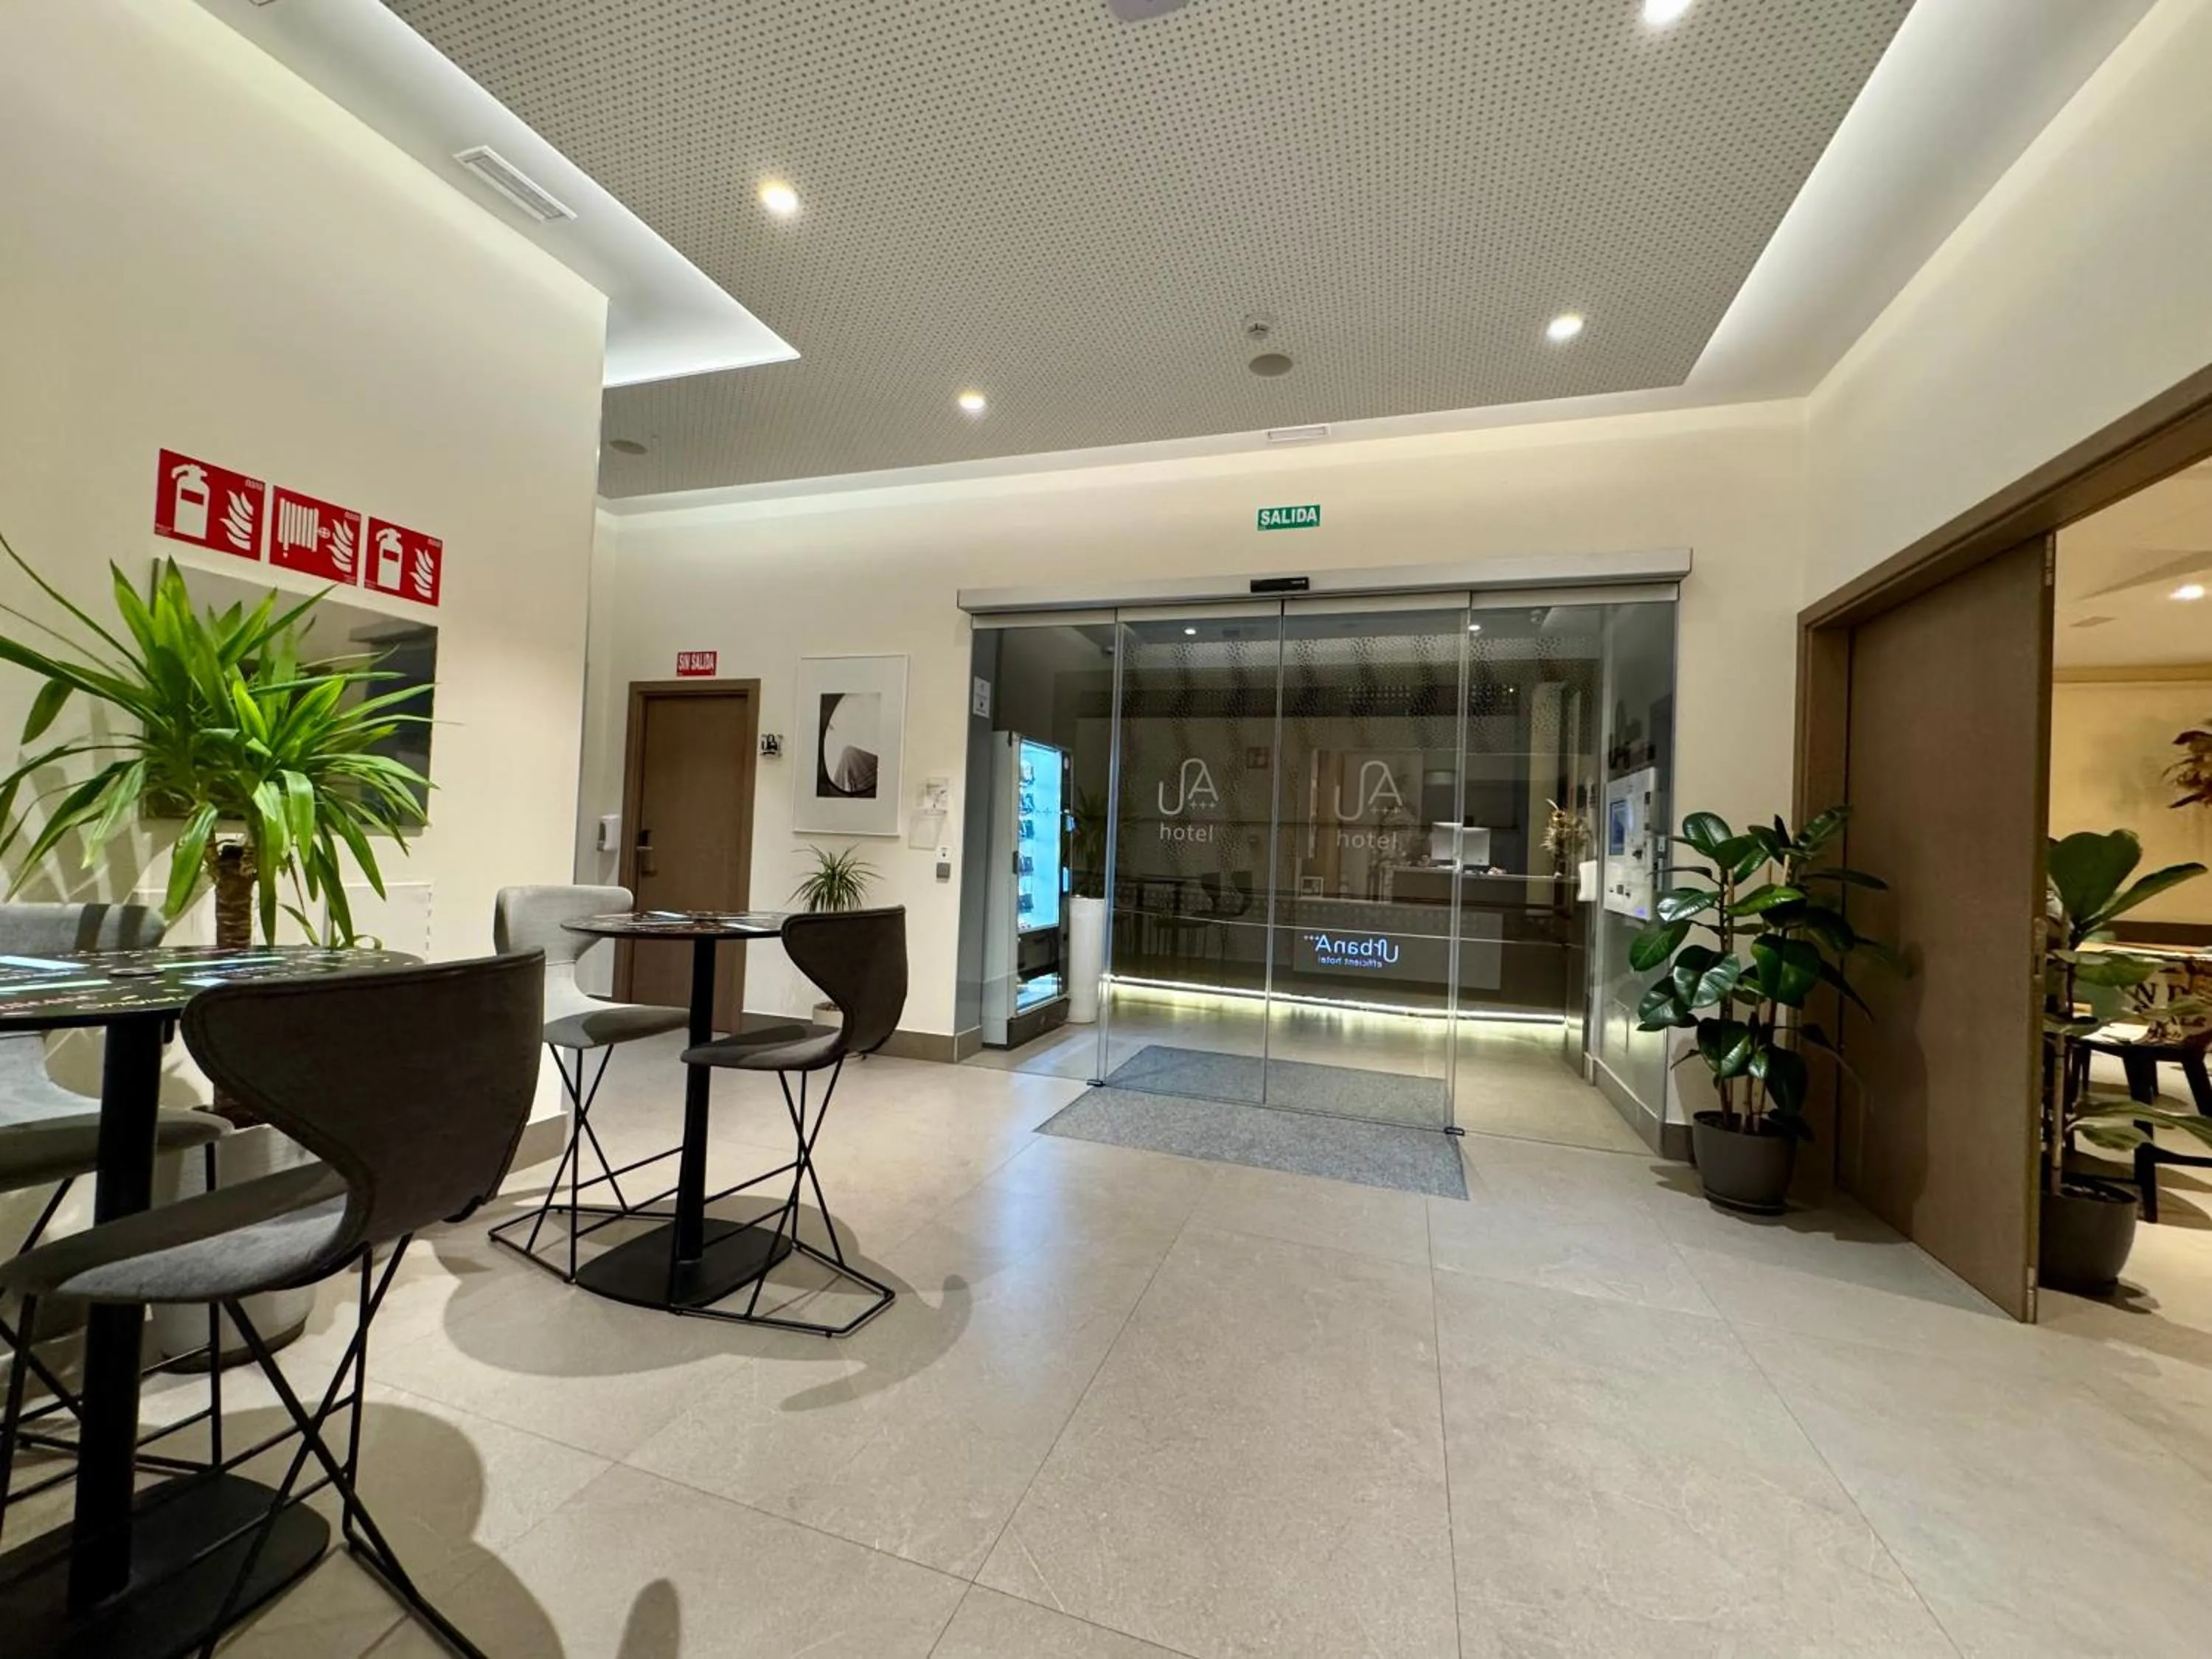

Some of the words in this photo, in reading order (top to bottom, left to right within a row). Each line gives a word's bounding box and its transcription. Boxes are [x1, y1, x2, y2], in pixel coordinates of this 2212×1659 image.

[1260, 507, 1318, 525] SALIDA
[679, 653, 690, 671] SIN
[691, 653, 714, 670] SALIDA
[1160, 822, 1214, 843] hotel
[1336, 830, 1398, 851] hotel
